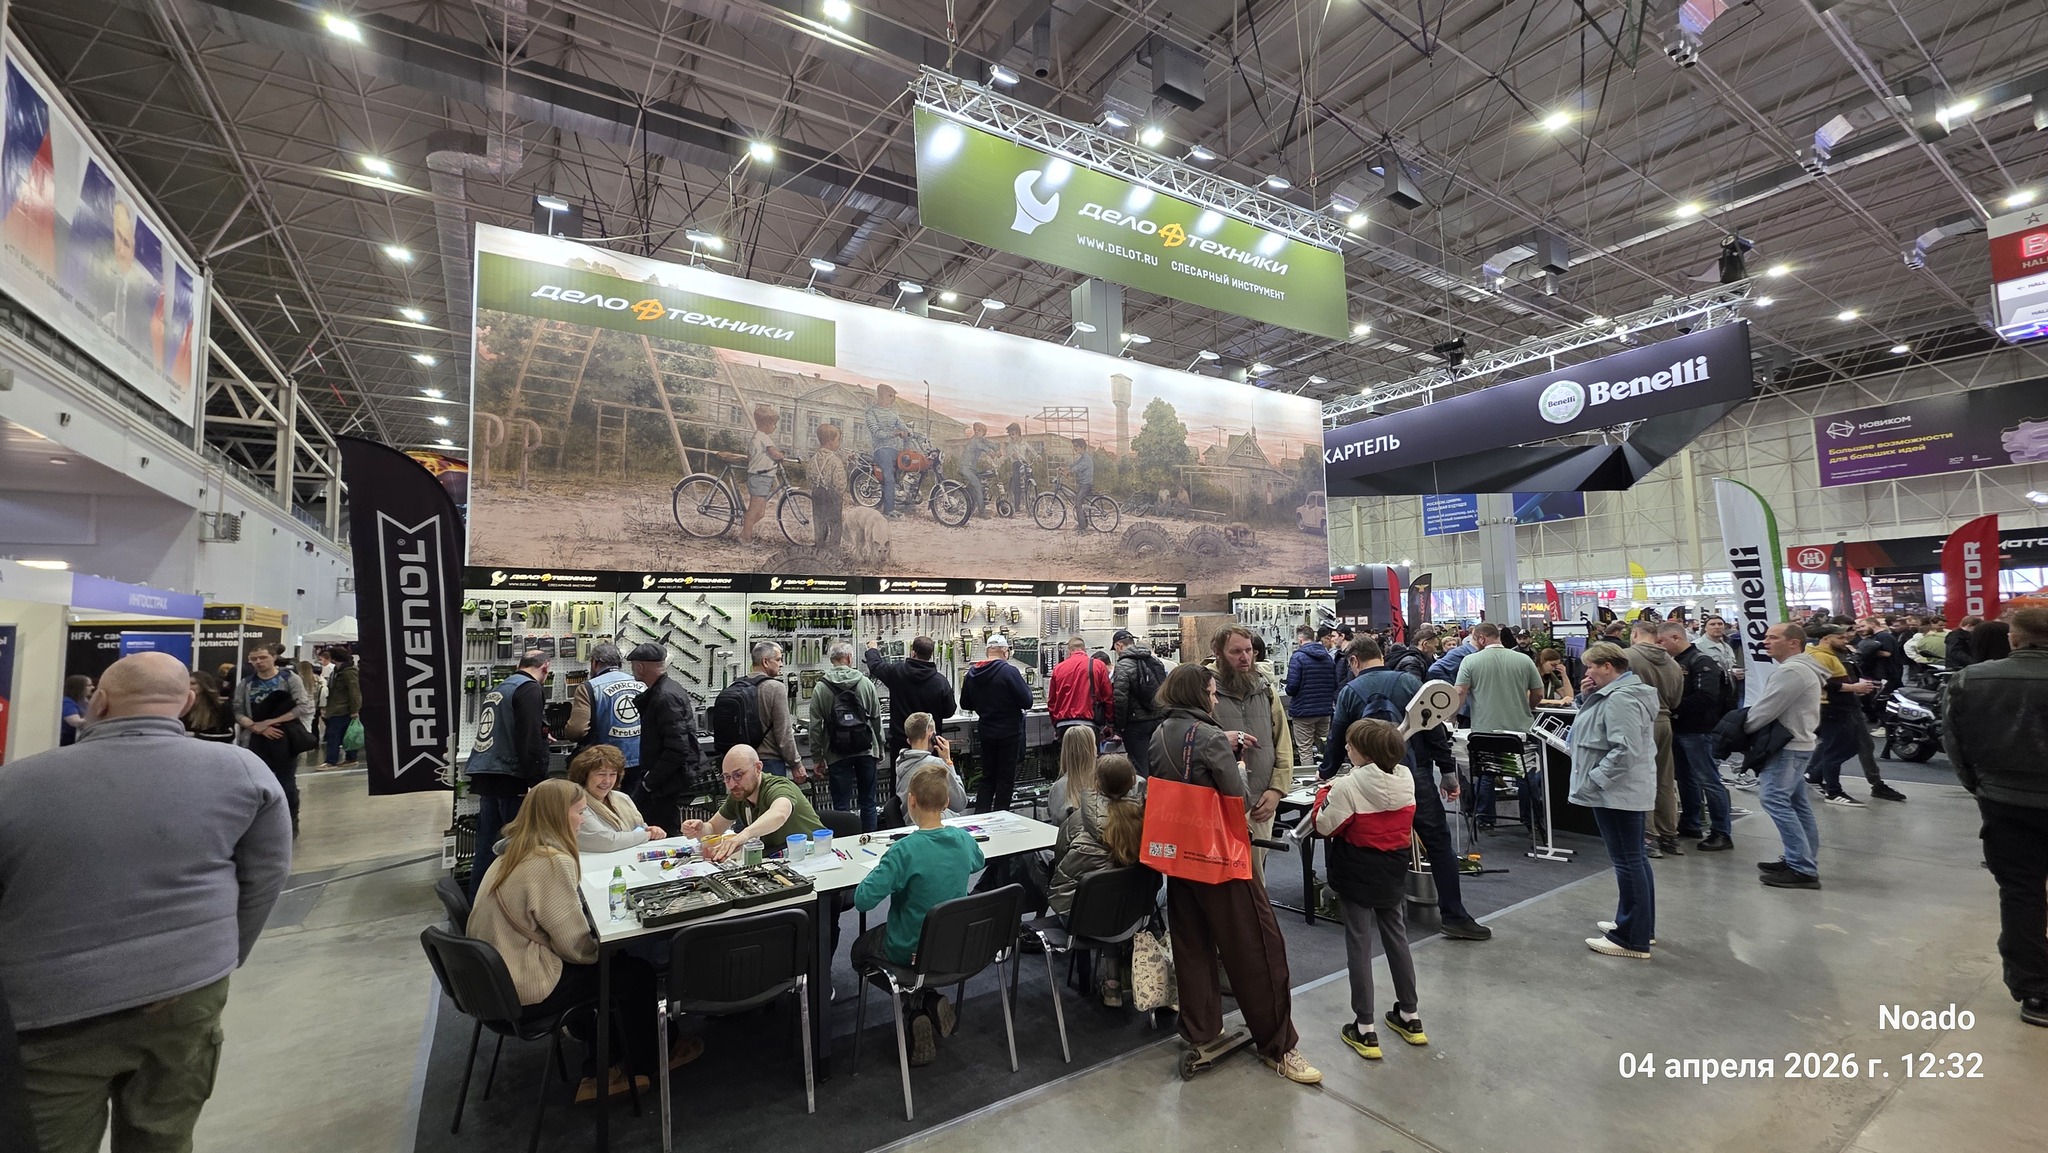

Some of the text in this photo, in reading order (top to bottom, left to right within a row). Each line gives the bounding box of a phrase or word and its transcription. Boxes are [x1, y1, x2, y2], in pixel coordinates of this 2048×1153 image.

[1076, 233, 1158, 266] WWW.DELOT.RU
[1171, 261, 1285, 300] СЛЕСАРНЫЙ ИНСТРУМЕНТ
[1588, 356, 1710, 406] Benelli
[1547, 396, 1576, 408] Benelli
[1859, 415, 1912, 430] НОВИКОМ
[1828, 432, 1953, 455] Большие возможности
[1829, 444, 1926, 464] для больших идей
[1963, 541, 1984, 620] OTOR
[71, 632, 91, 640] HFK
[216, 630, 263, 640] надёная
[399, 539, 438, 747] RAVENOL
